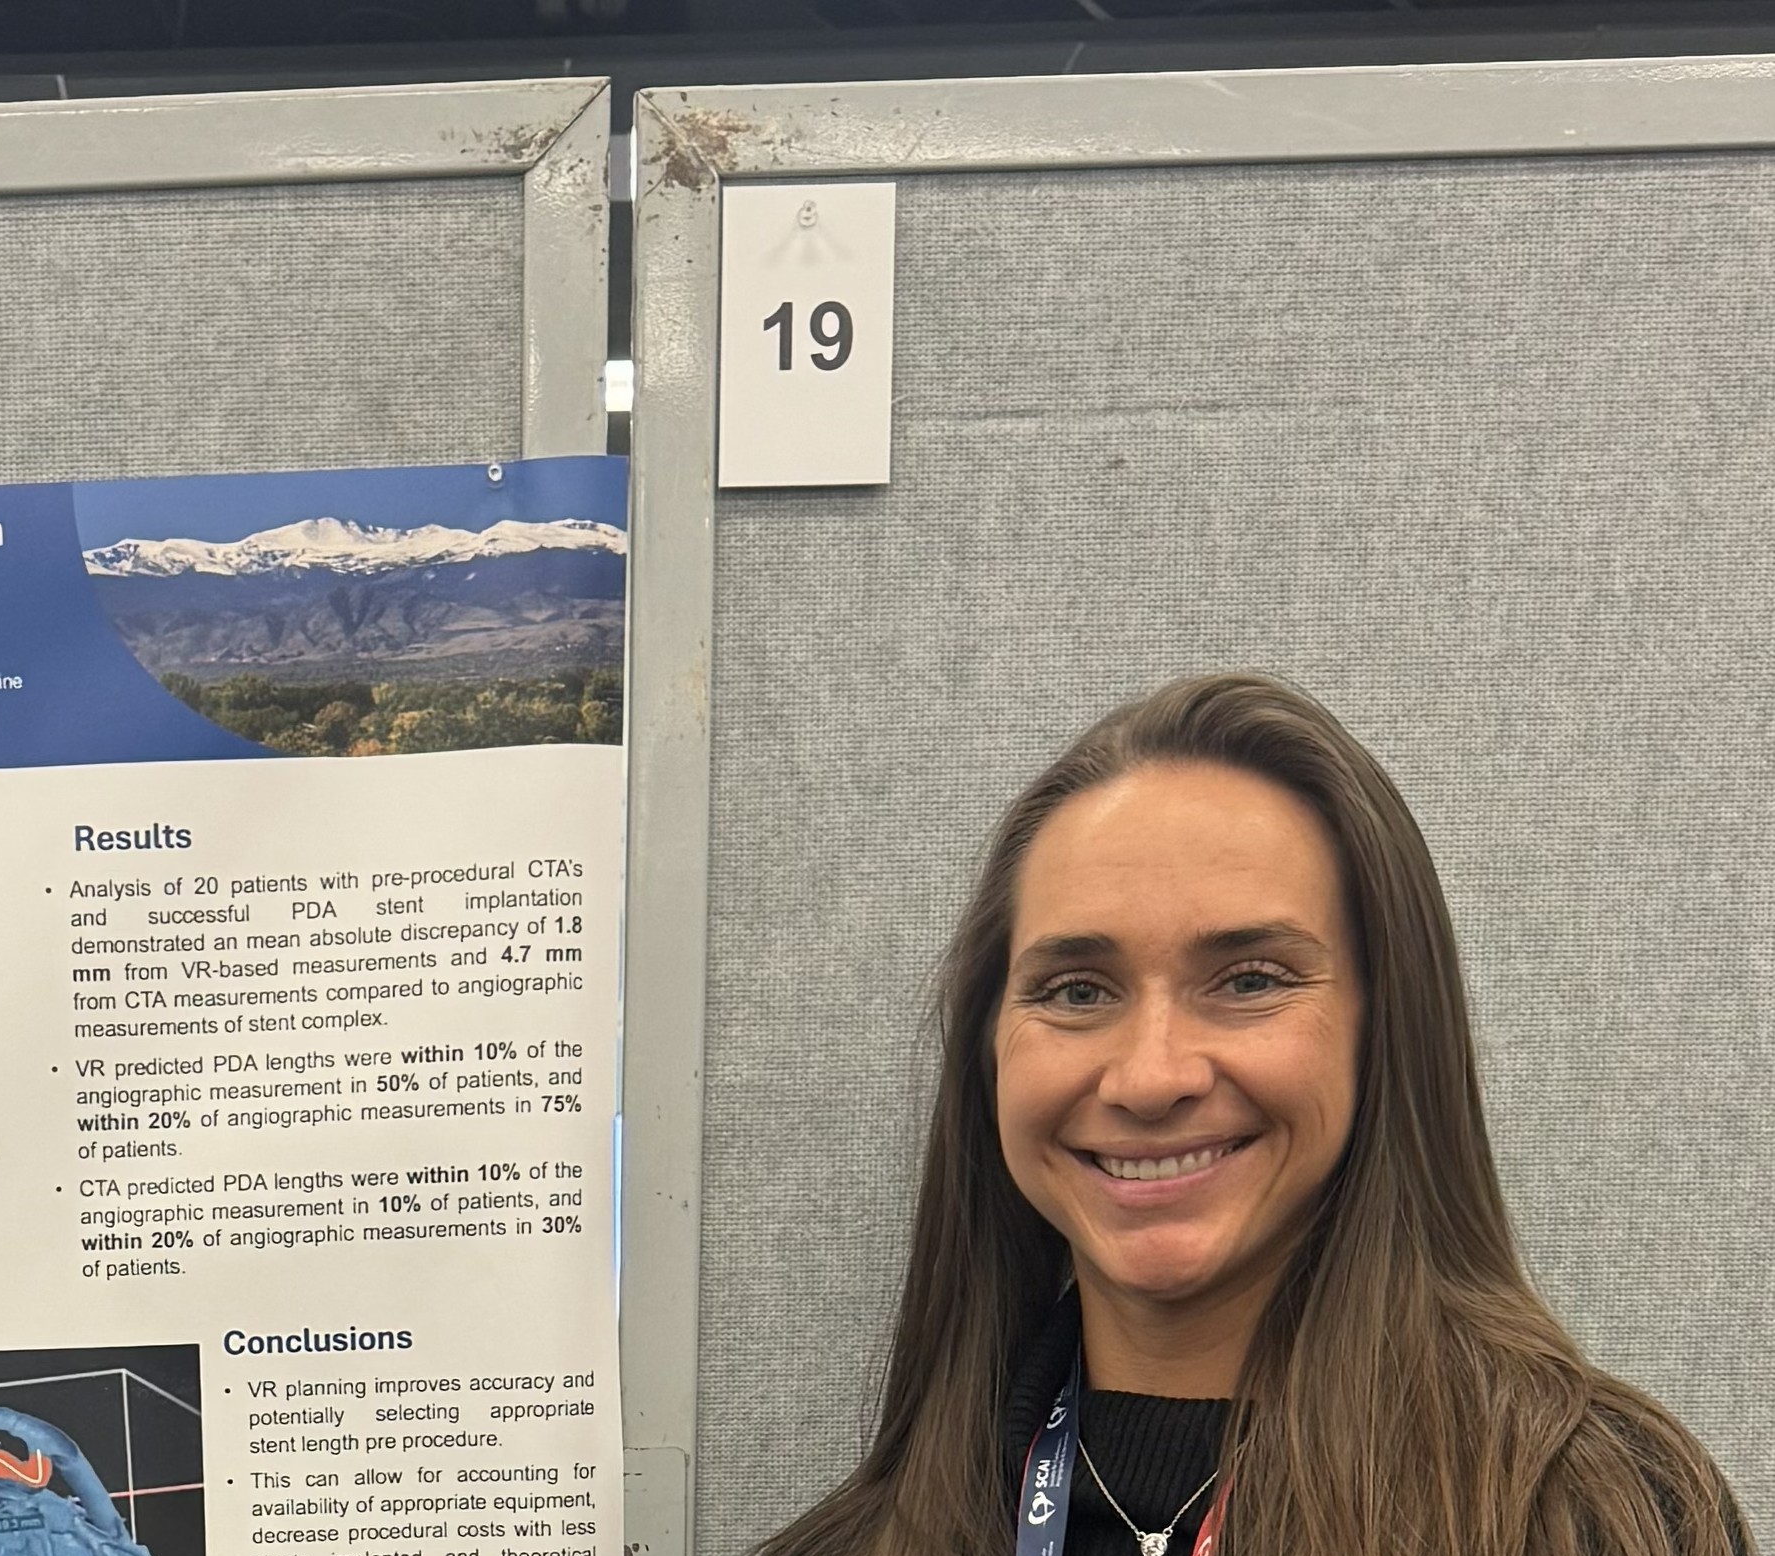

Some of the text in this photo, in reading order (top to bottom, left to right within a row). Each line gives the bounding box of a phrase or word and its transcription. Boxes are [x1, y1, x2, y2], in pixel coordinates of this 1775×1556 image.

[763, 301, 854, 371] 19
[74, 822, 192, 852] Results
[74, 1039, 583, 1081] VR predicted PDA lengths were within 10% of the
[76, 1067, 582, 1109] angiographic measurement in 50% of patients, and
[76, 1094, 582, 1132] within 20% of angiographic measurements in 75%
[223, 1325, 413, 1356] Conclusions
[247, 1370, 595, 1401] VR planning improves accuracy and
[249, 1399, 595, 1431] potentially selecting appropriate
[1035, 1459, 1051, 1488] SCAI
